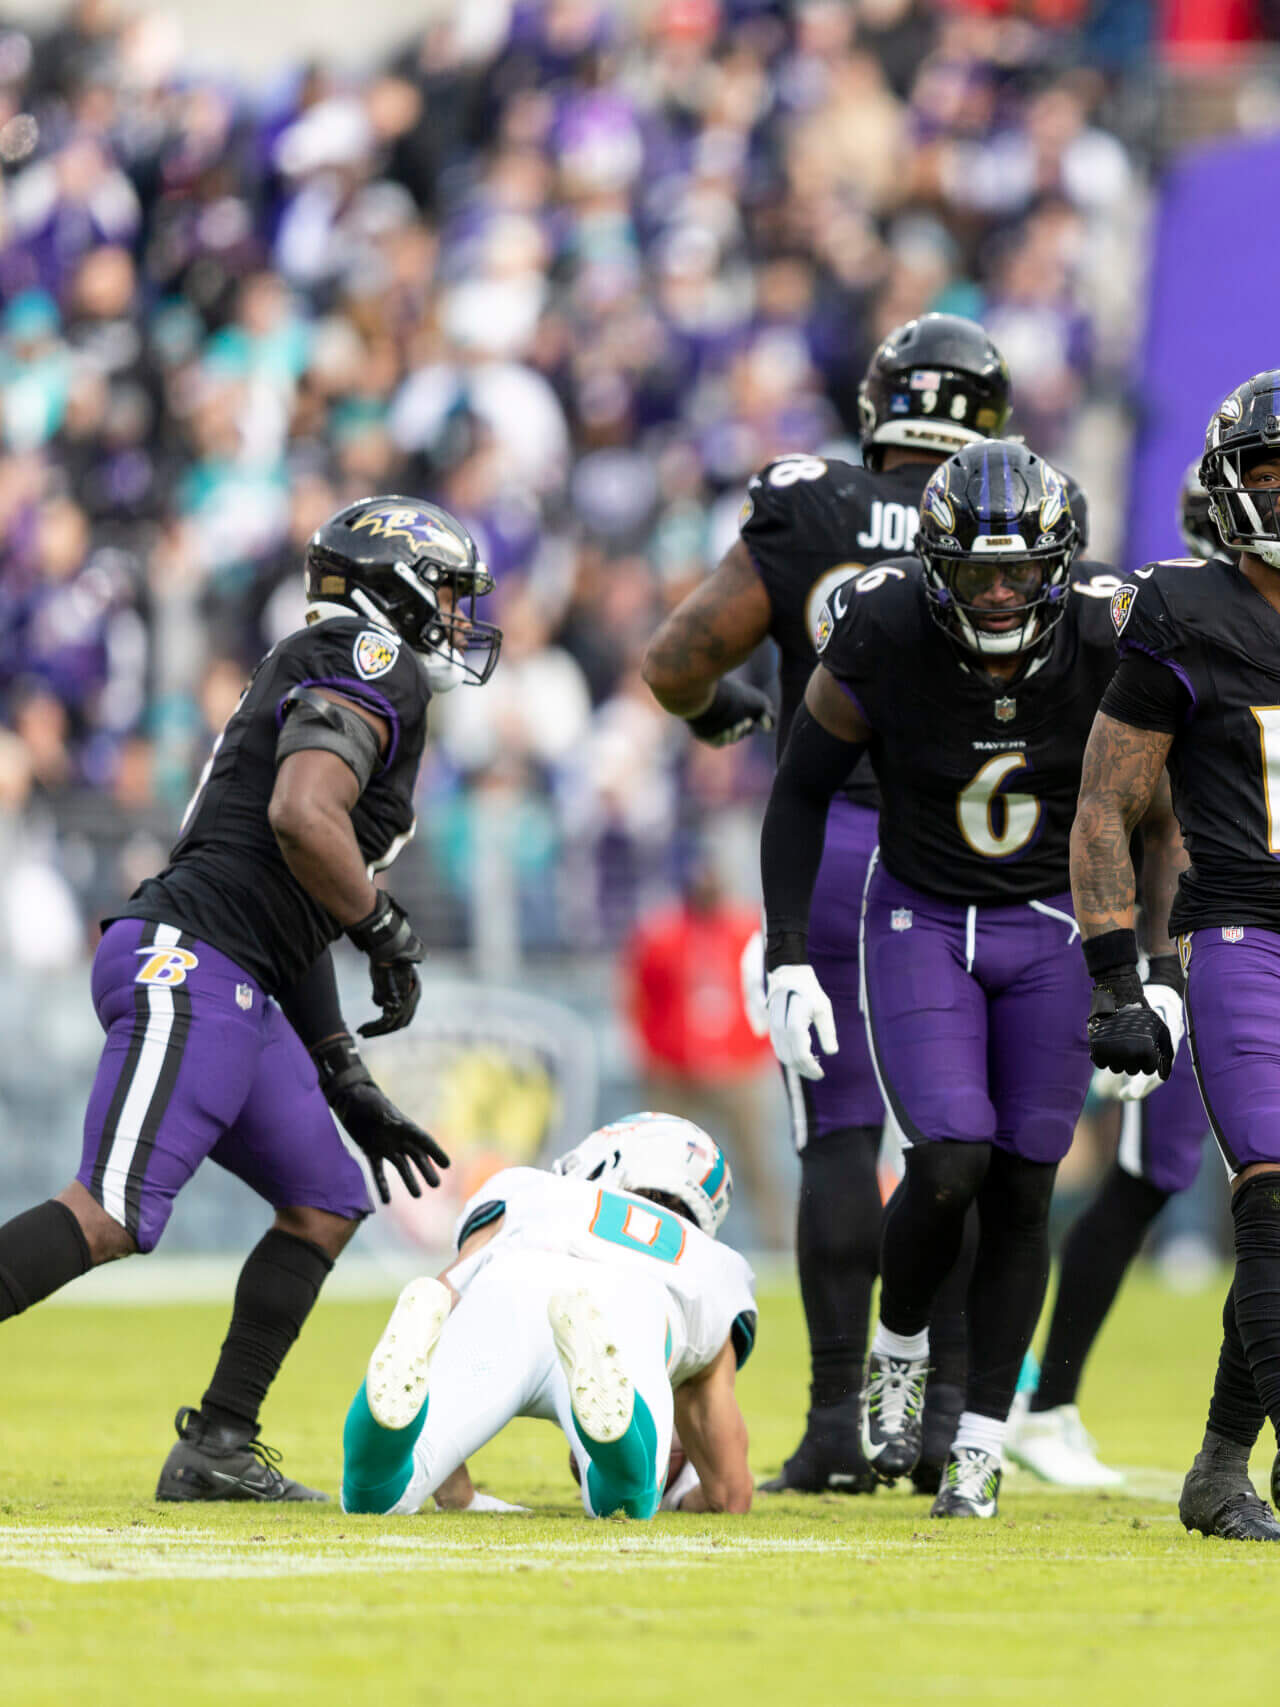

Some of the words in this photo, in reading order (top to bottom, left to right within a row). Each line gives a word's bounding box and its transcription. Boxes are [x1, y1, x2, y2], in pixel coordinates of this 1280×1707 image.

[970, 740, 1028, 751] RAVENS
[956, 751, 1044, 859] 6
[133, 945, 200, 987] B
